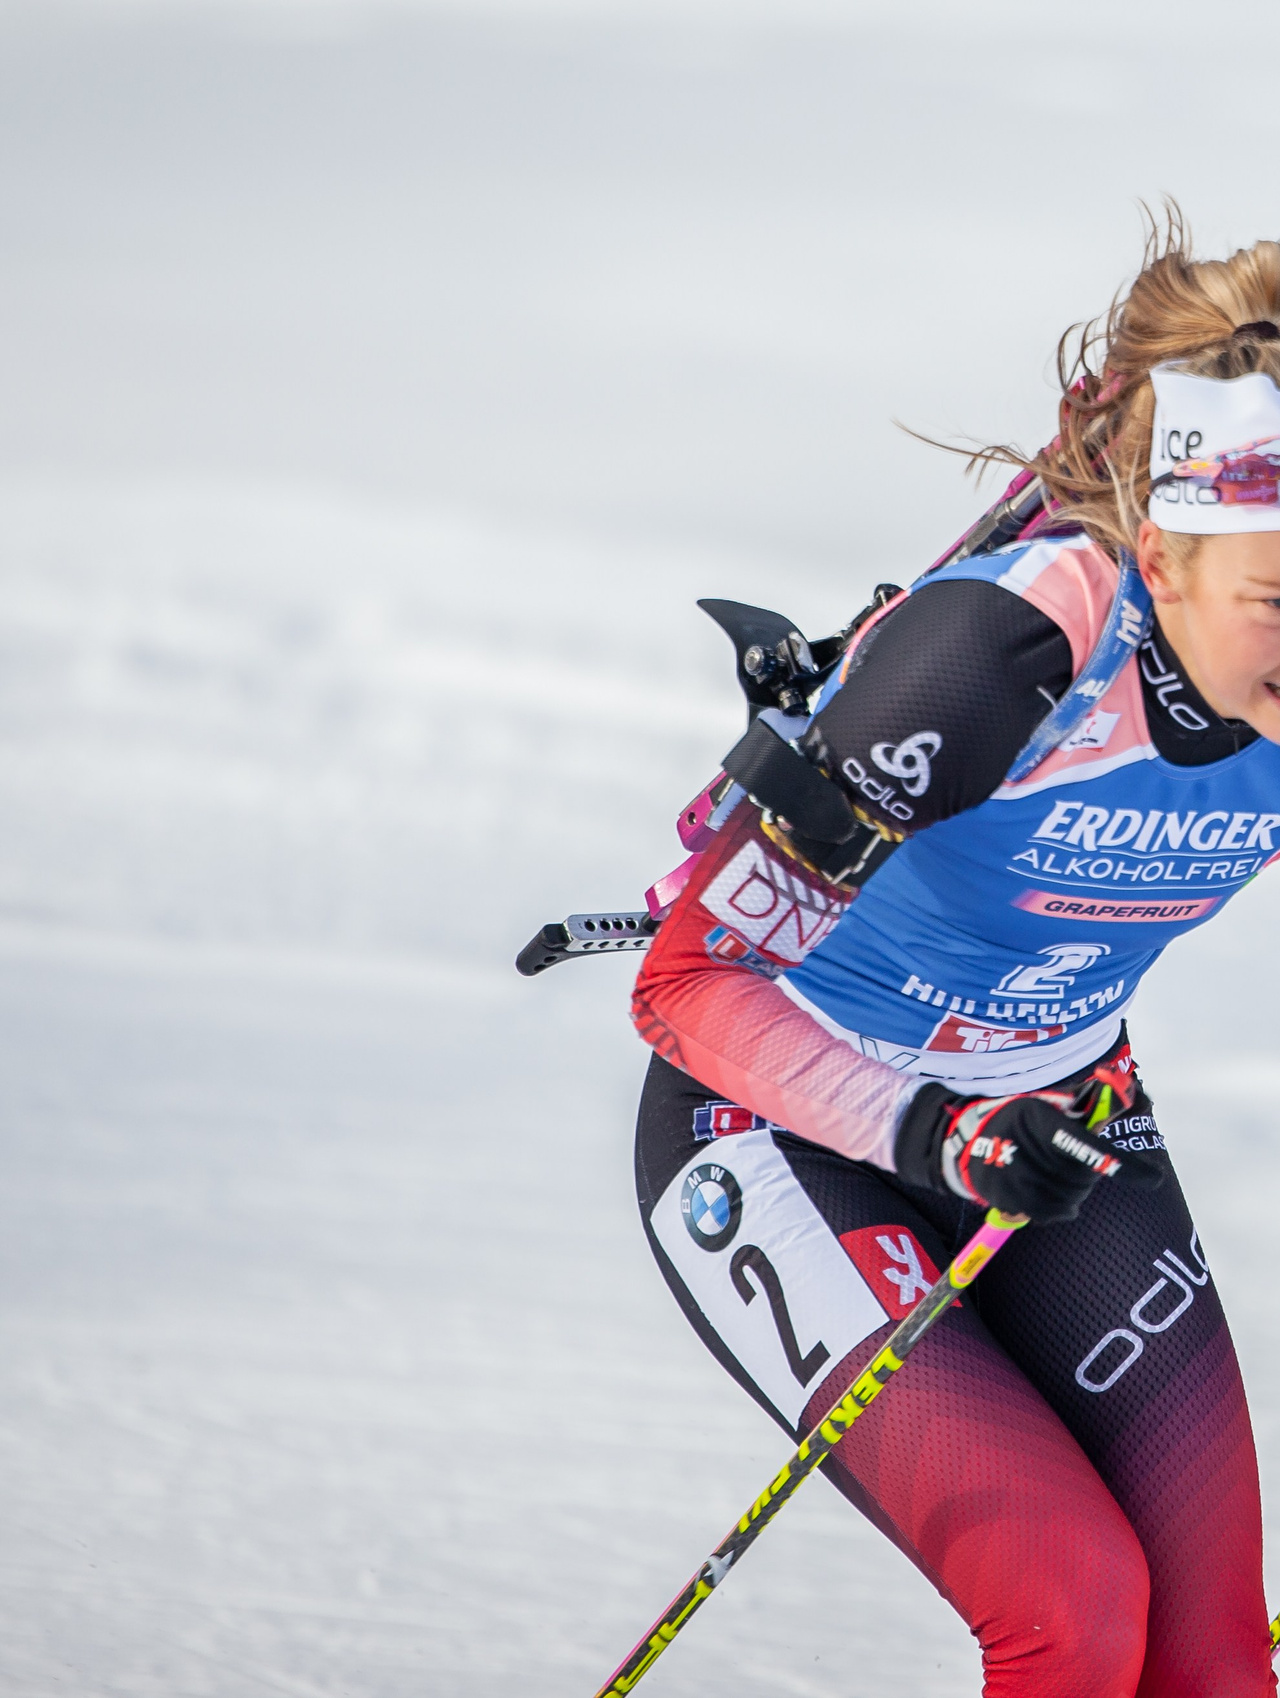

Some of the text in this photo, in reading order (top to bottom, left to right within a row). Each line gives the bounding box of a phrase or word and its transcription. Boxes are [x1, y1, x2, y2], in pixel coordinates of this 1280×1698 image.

[842, 757, 914, 821] odlo
[1012, 848, 1262, 882] ALKOHOLFREI
[1043, 900, 1200, 918] GRAPEFRUIT
[991, 943, 1111, 999] 2
[682, 1166, 725, 1213] BMW
[730, 1243, 831, 1389] 2
[820, 1346, 904, 1444] LEKI
